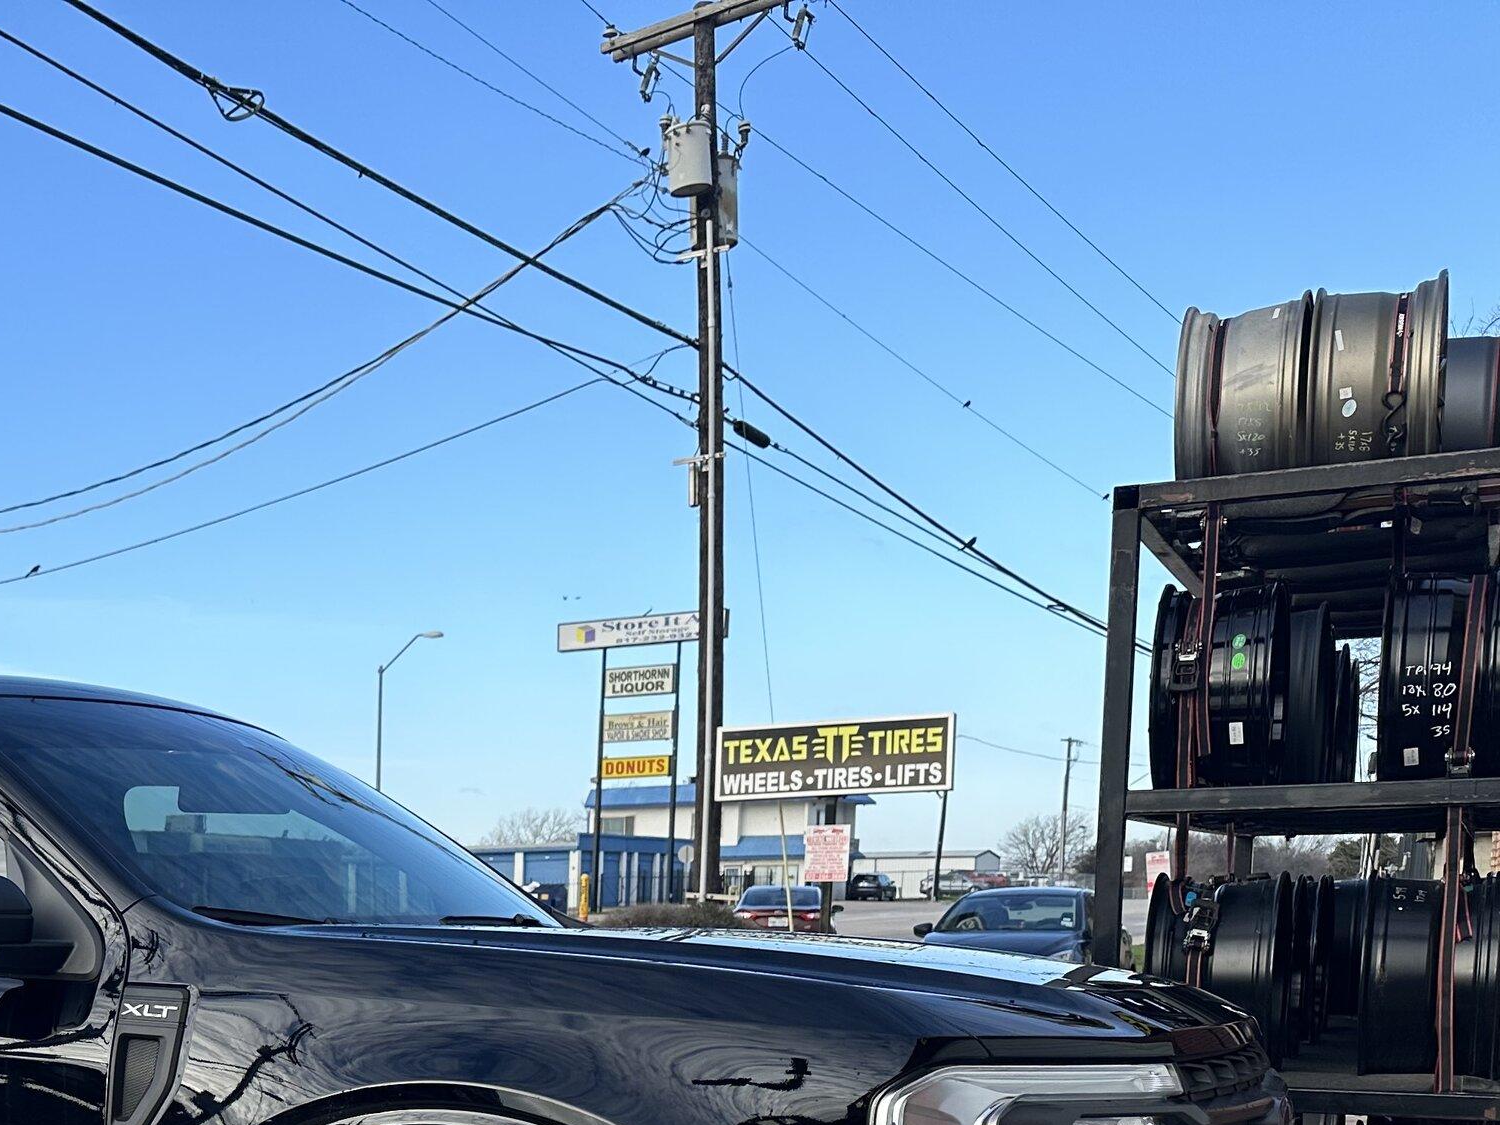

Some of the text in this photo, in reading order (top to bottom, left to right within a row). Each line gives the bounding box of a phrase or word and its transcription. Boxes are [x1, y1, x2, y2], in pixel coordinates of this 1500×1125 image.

[601, 619, 659, 633] Store
[663, 613, 680, 626] It
[608, 668, 670, 684] SHORTHORNN
[611, 680, 665, 694] LIQUOR
[646, 717, 668, 728] Hair
[723, 735, 809, 765] TEXAS
[868, 727, 944, 756] TIRES
[605, 759, 665, 775] DONUTS
[723, 762, 943, 795] WHEELS TIRES LIFTS
[120, 1002, 178, 1019] XLT
